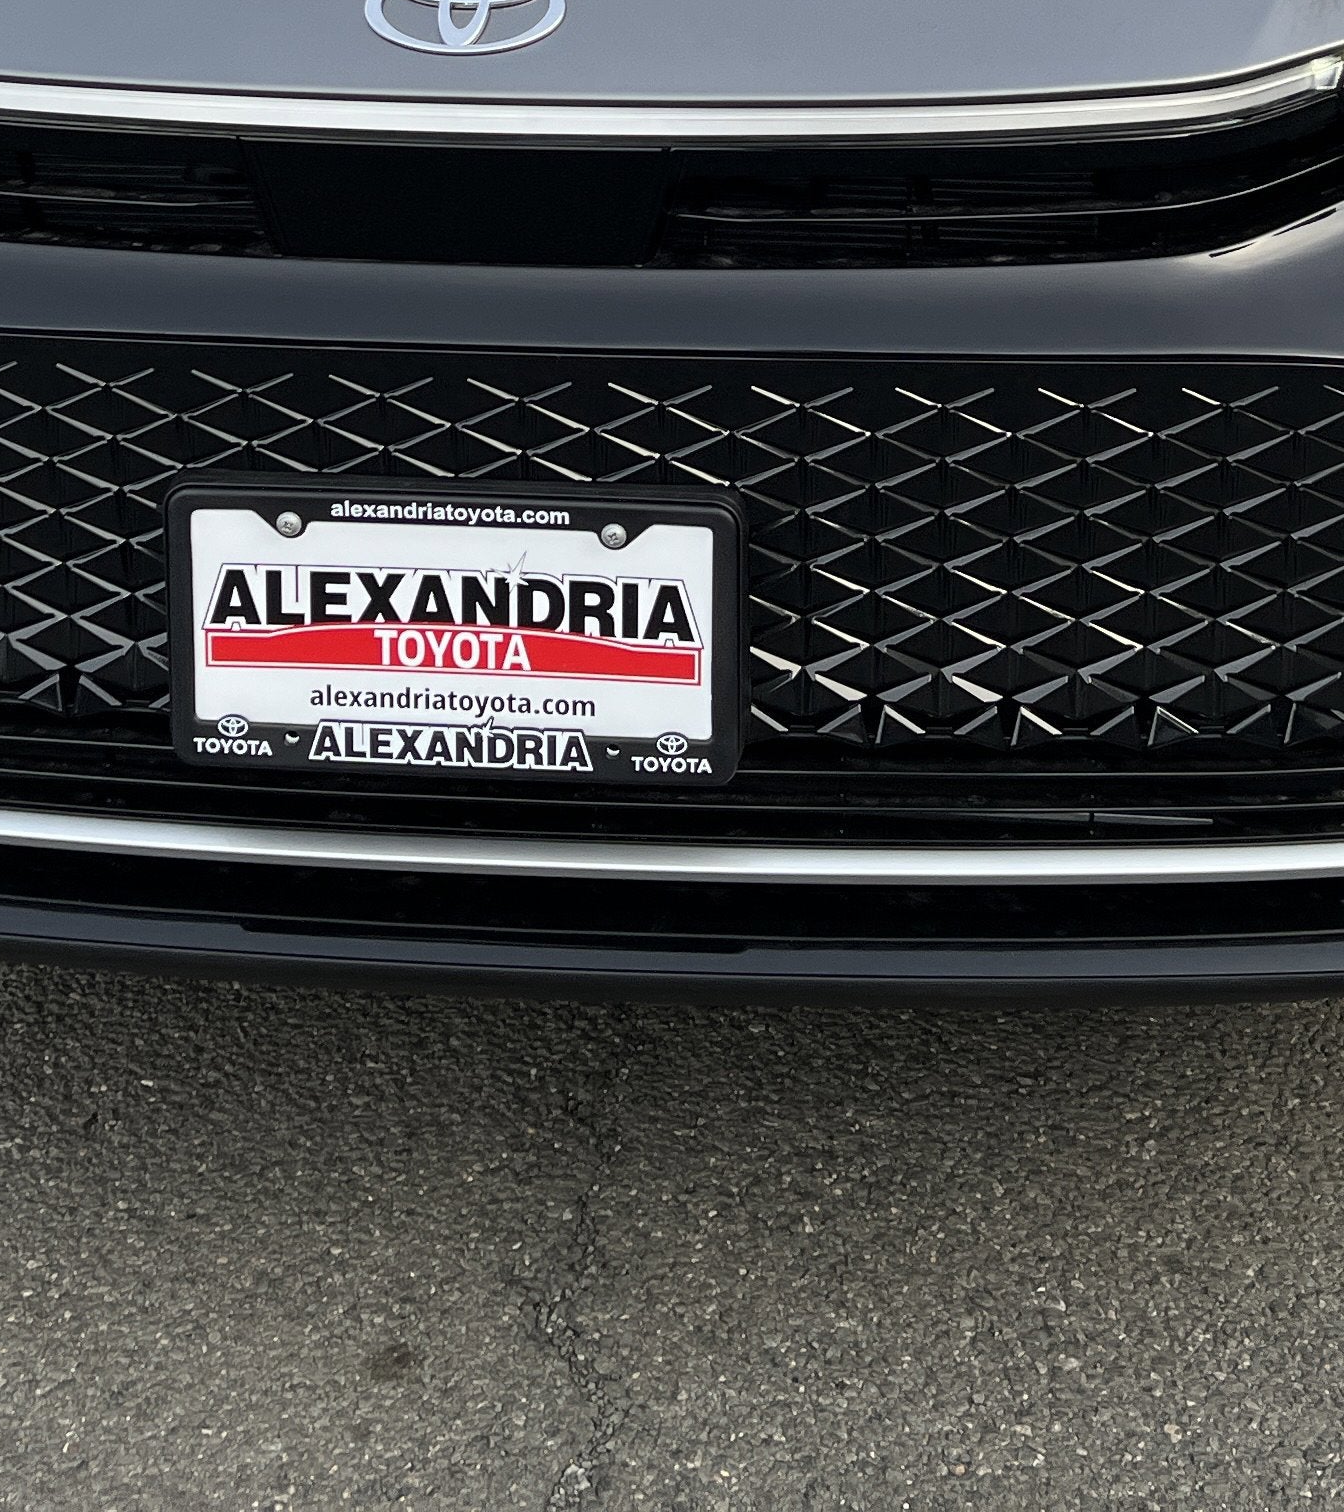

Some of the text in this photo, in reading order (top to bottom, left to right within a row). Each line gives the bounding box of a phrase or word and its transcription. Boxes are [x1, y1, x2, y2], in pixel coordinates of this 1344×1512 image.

[330, 500, 570, 525] alexandriatoyota.com
[207, 566, 699, 645] ALEXANDRIA
[373, 628, 532, 672] TOYOTA
[310, 684, 596, 718] alexandriatoyota.com
[193, 737, 273, 757] TOYOTA
[309, 720, 594, 772] ALEXANDRIA
[630, 756, 713, 774] TOYOTA
